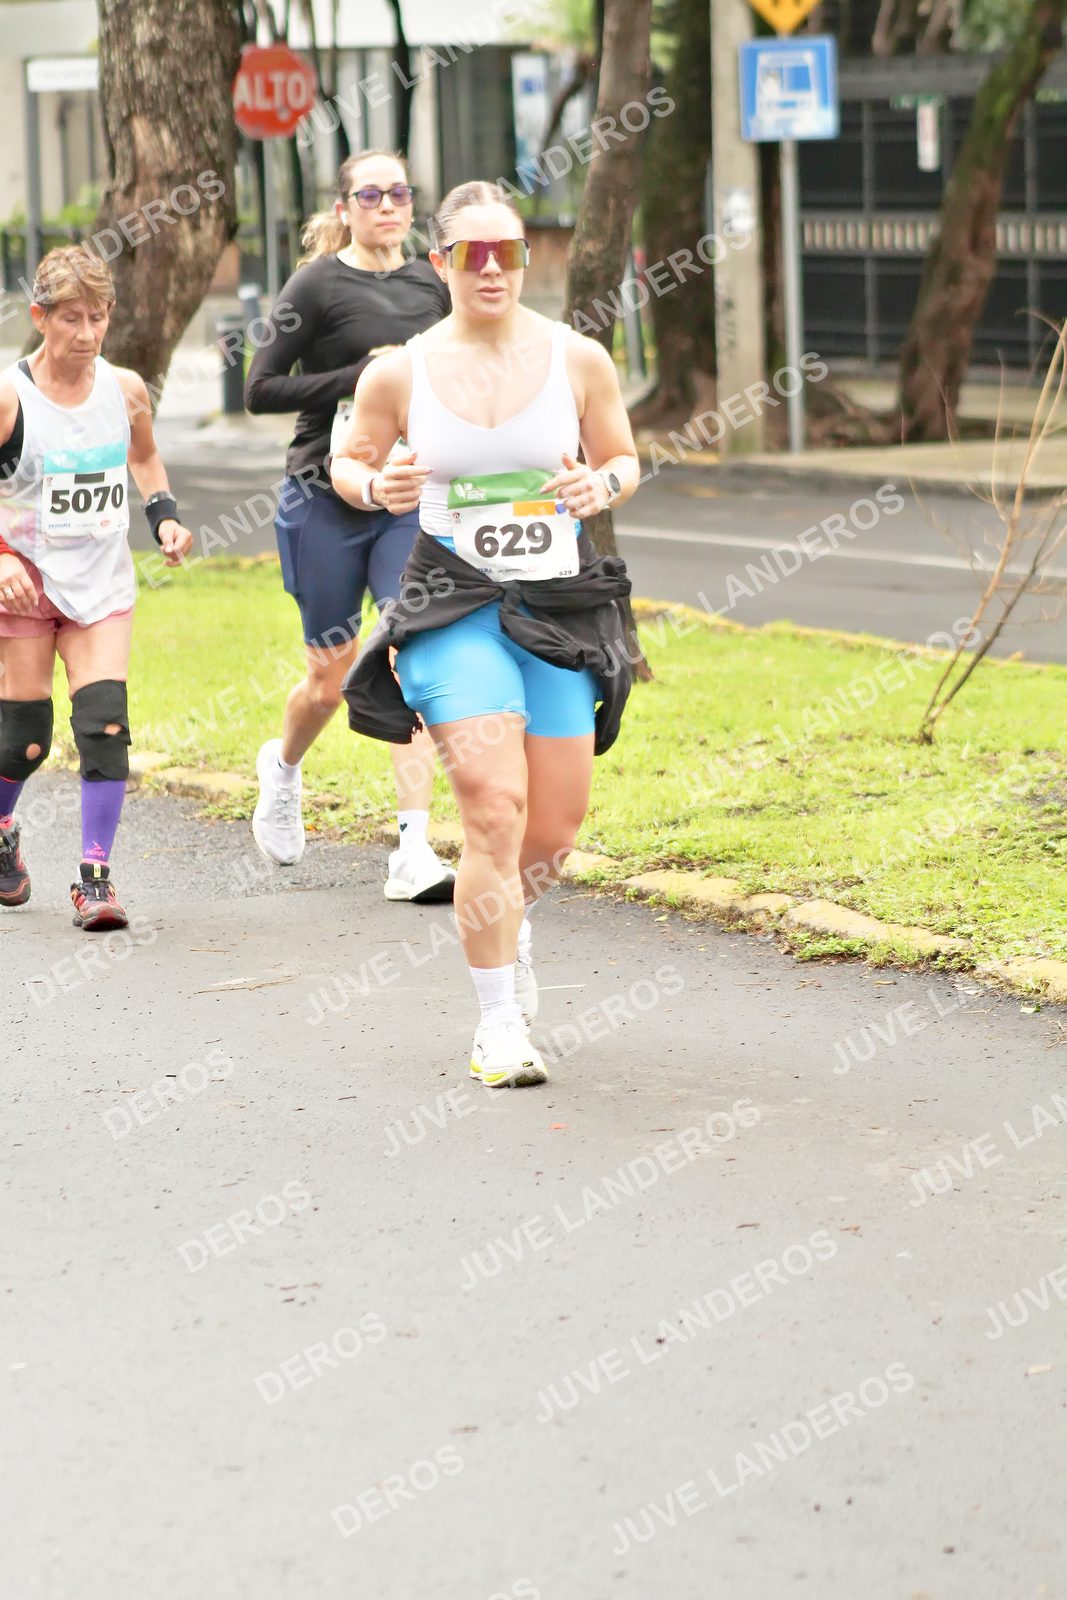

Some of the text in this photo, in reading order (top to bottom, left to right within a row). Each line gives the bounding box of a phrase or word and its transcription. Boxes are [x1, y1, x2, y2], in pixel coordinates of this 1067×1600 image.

[234, 71, 308, 111] ALTO
[50, 483, 124, 514] 5070
[475, 522, 552, 558] 629
[559, 569, 573, 577] 629
